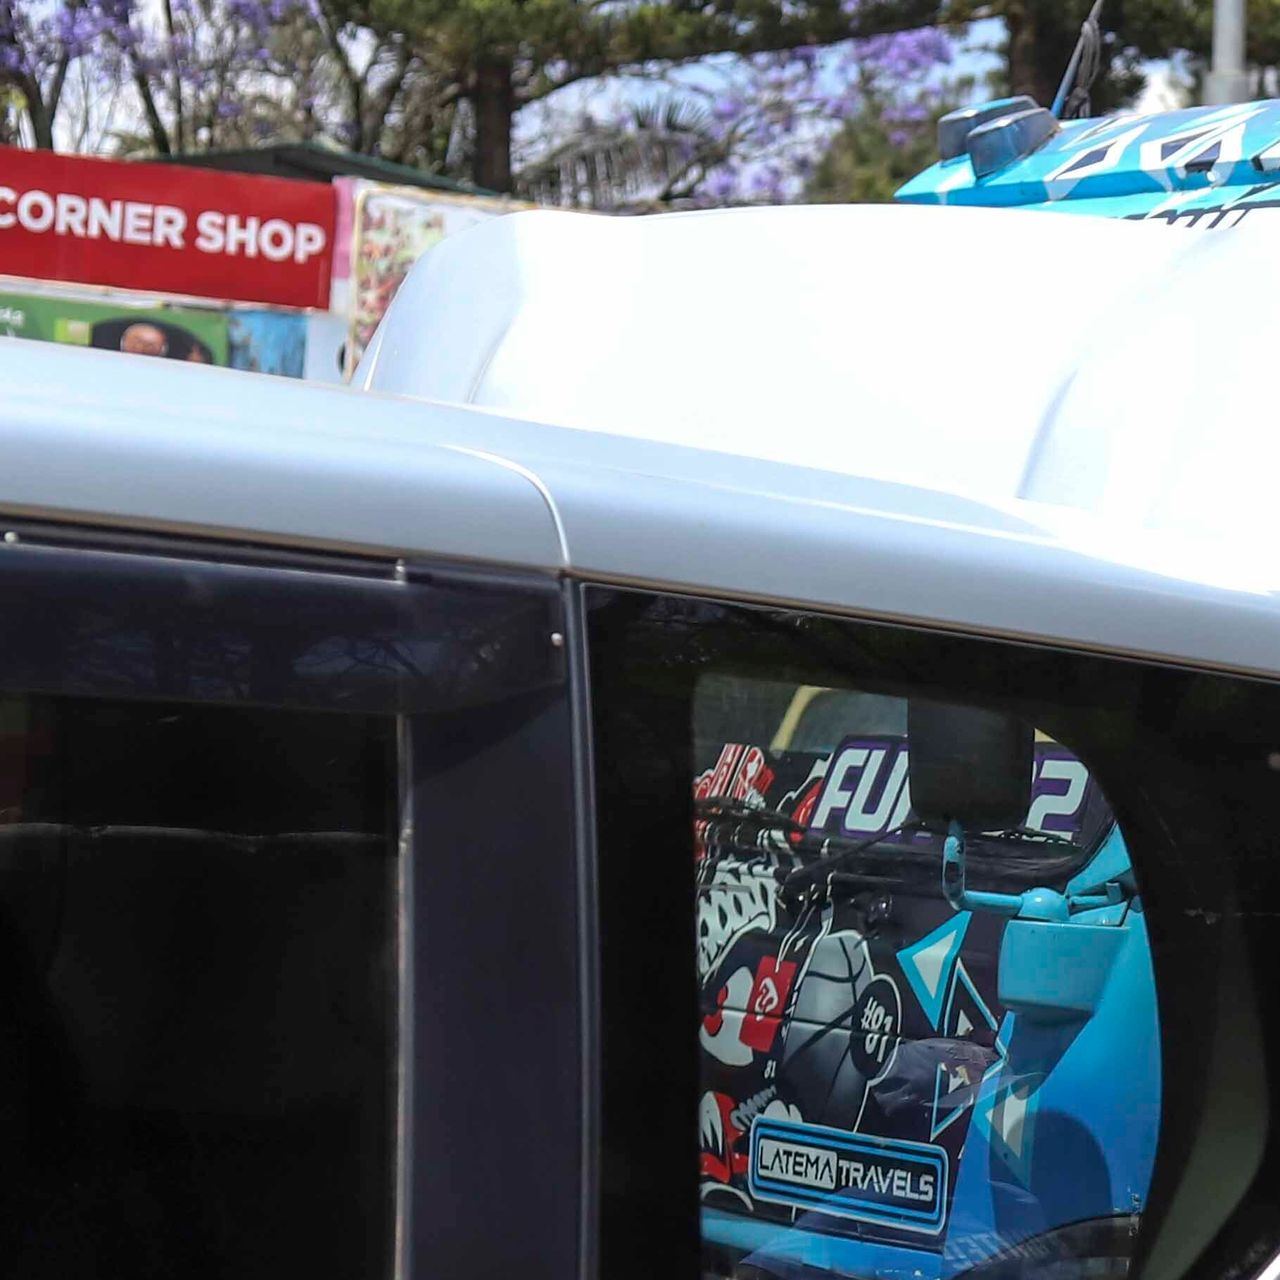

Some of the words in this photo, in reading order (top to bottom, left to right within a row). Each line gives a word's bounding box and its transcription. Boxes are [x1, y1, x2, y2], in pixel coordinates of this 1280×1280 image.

[0, 187, 186, 249] CORNER
[195, 211, 326, 264] SHOP
[759, 1145, 834, 1184] LATEMA
[838, 1159, 935, 1202] TRAVELS
